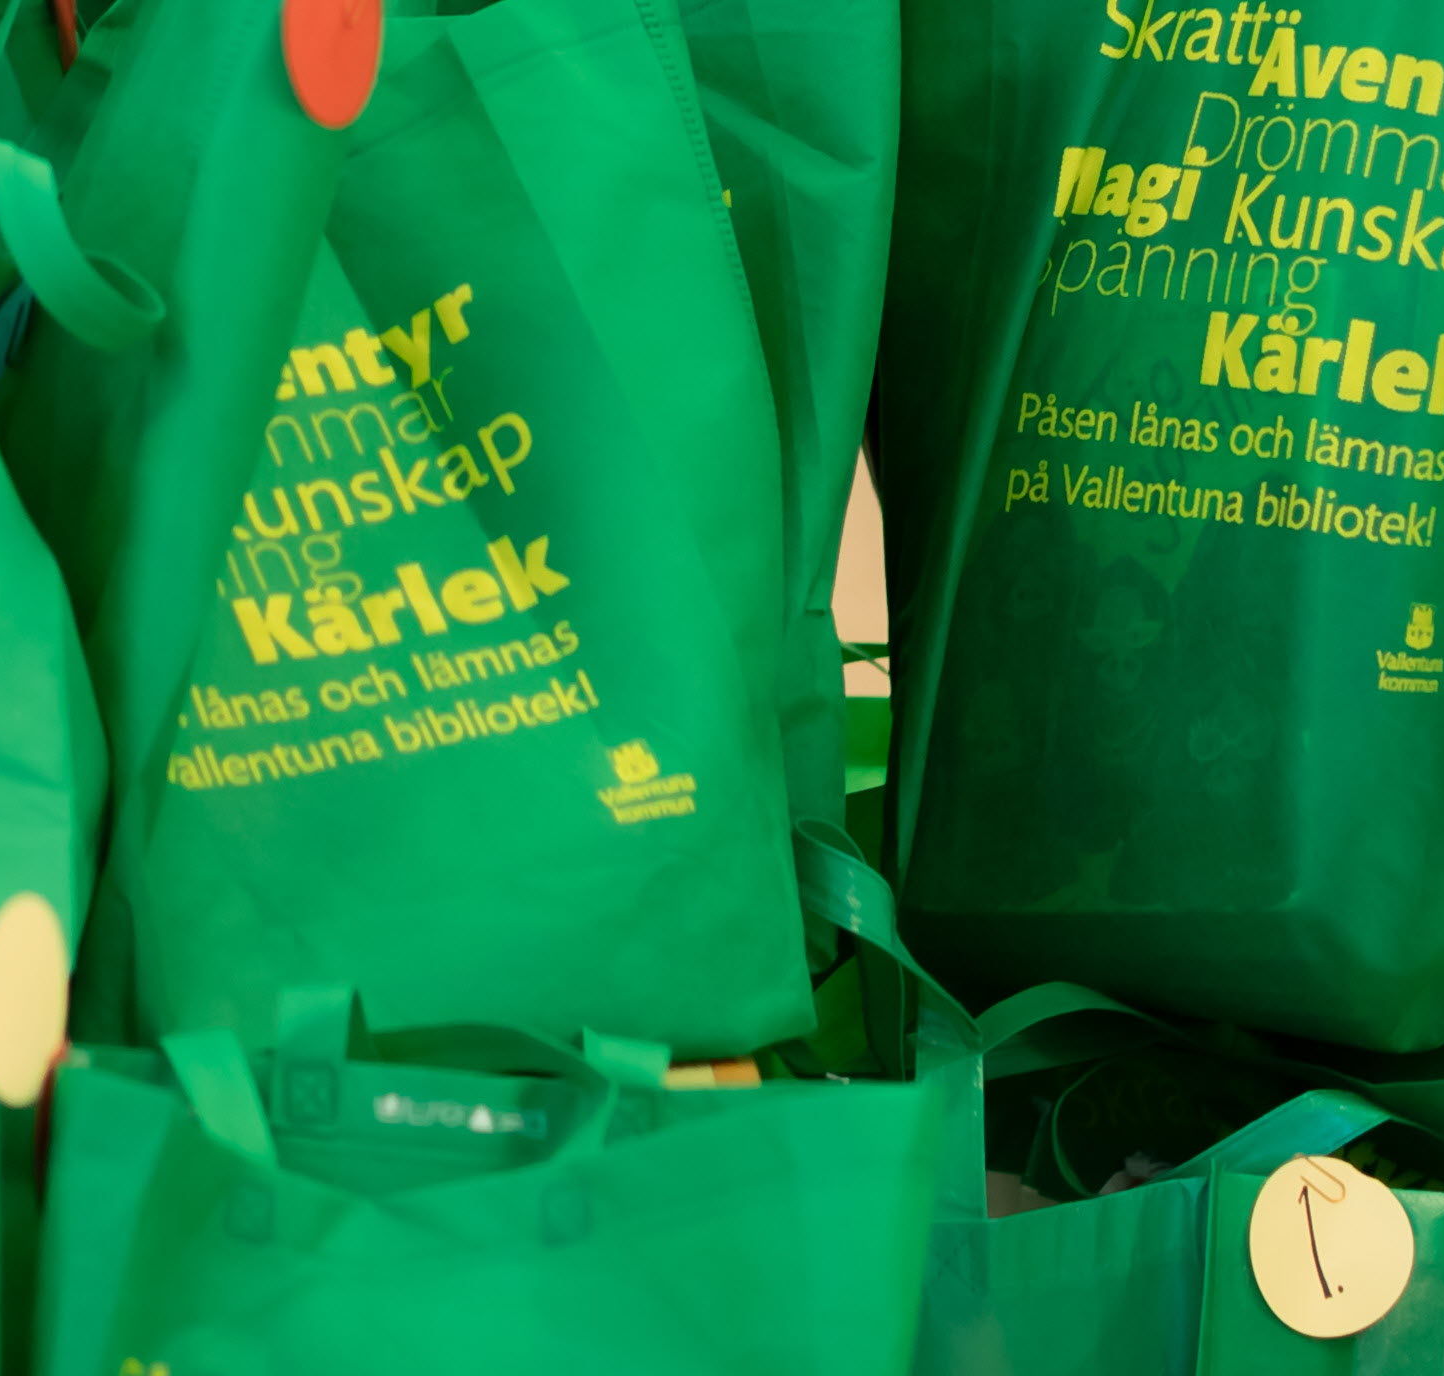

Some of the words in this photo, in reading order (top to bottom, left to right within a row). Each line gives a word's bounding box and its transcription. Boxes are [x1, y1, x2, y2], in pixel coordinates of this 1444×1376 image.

[1038, 223, 1327, 335] pänning
[232, 412, 532, 543] unskap
[1017, 392, 1117, 443] Påsen
[1130, 400, 1220, 453] lånas
[1229, 415, 1295, 459] och
[1005, 460, 1049, 513] på
[1063, 463, 1244, 525] Vallentuna
[1255, 481, 1436, 548] bibliotek!
[232, 535, 571, 666] Kärlek
[190, 683, 310, 730] lånas
[319, 664, 407, 712] och
[410, 620, 580, 693] lämnas
[383, 669, 600, 754] bibliotek!
